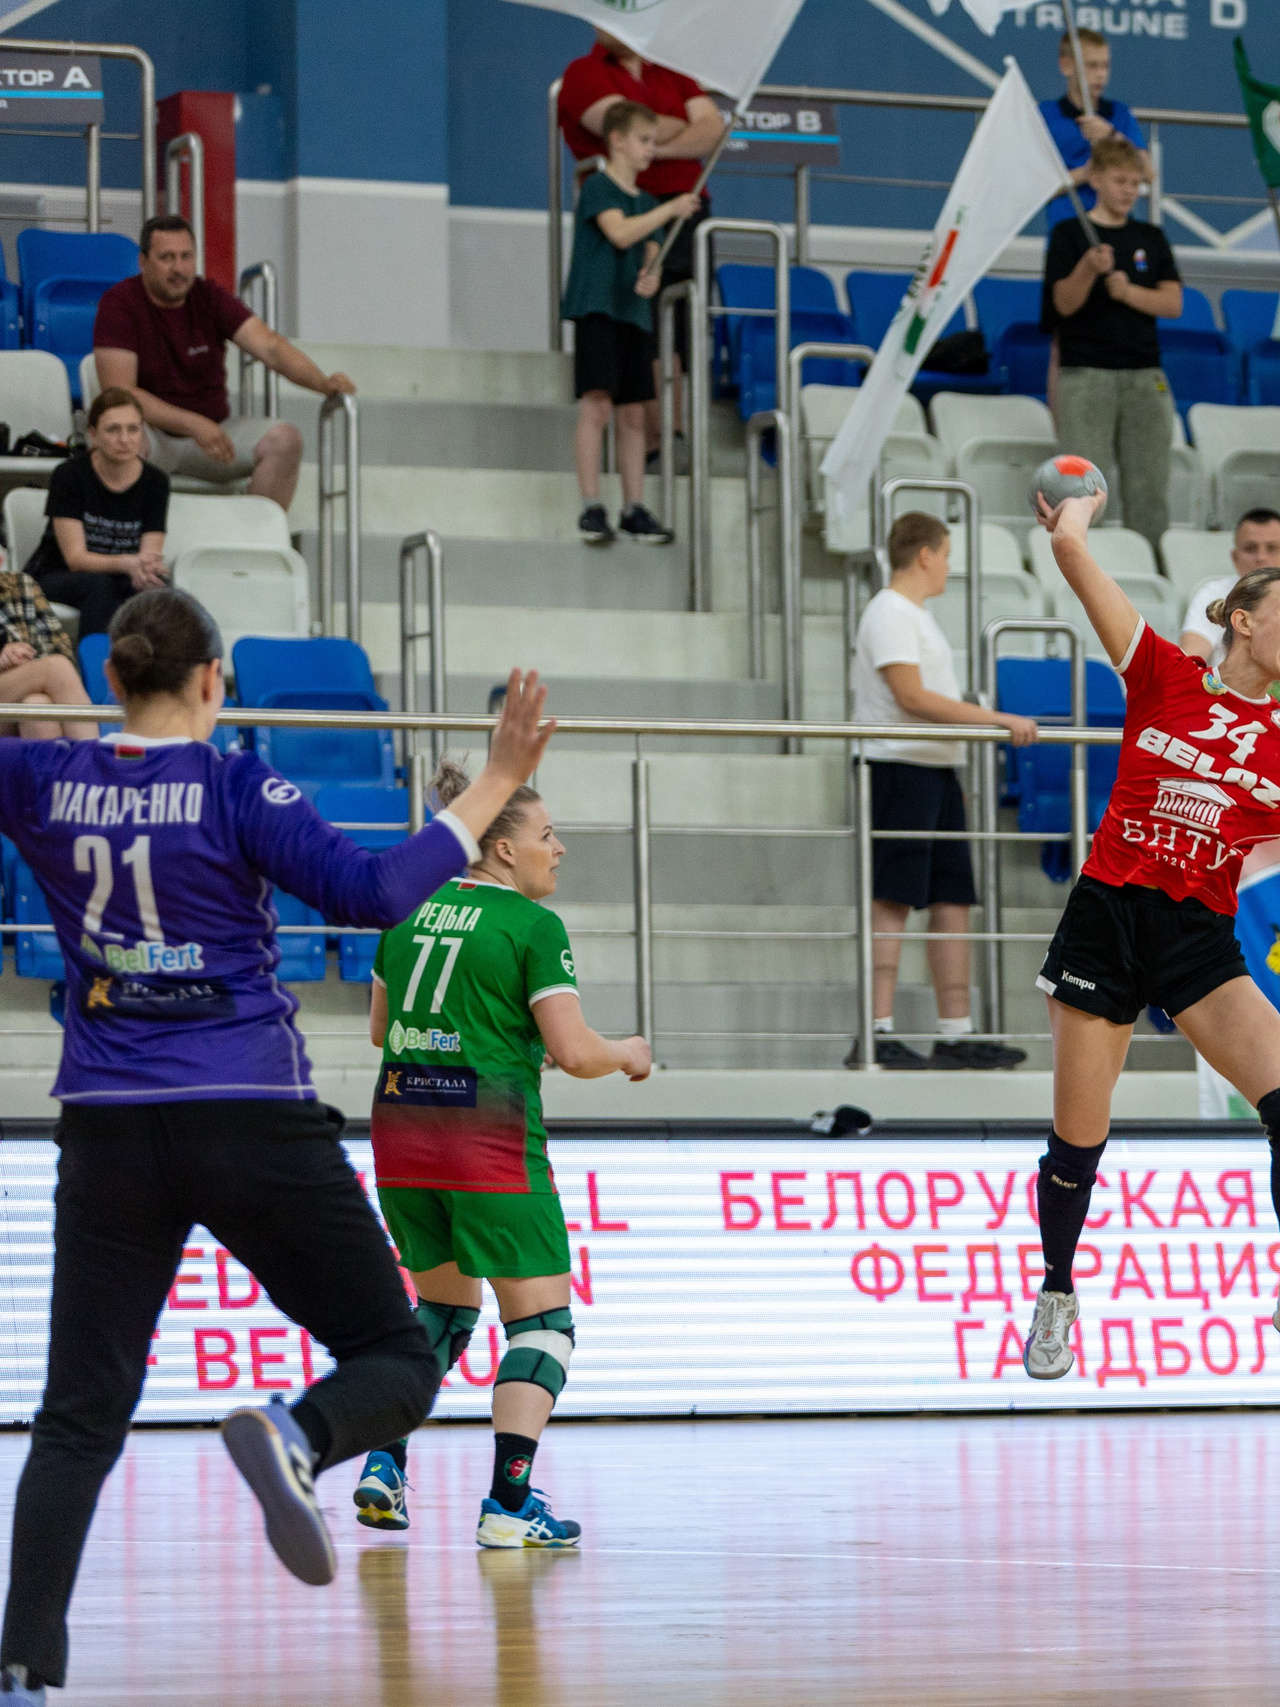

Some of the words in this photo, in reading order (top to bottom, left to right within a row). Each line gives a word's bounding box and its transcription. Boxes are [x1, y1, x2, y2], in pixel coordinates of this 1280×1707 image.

[1008, 5, 1187, 40] TRBUNE
[0, 69, 54, 86] ТОР
[1188, 702, 1269, 766] 34
[1122, 817, 1238, 871] БНТУ
[73, 834, 166, 944] 21
[414, 901, 483, 934] РЕДЬКА
[104, 941, 205, 973] BelFert
[402, 933, 464, 1015] 77
[1061, 969, 1097, 991] Kempa
[405, 1027, 461, 1053] BelFert
[1051, 1173, 1078, 1189] SELECT
